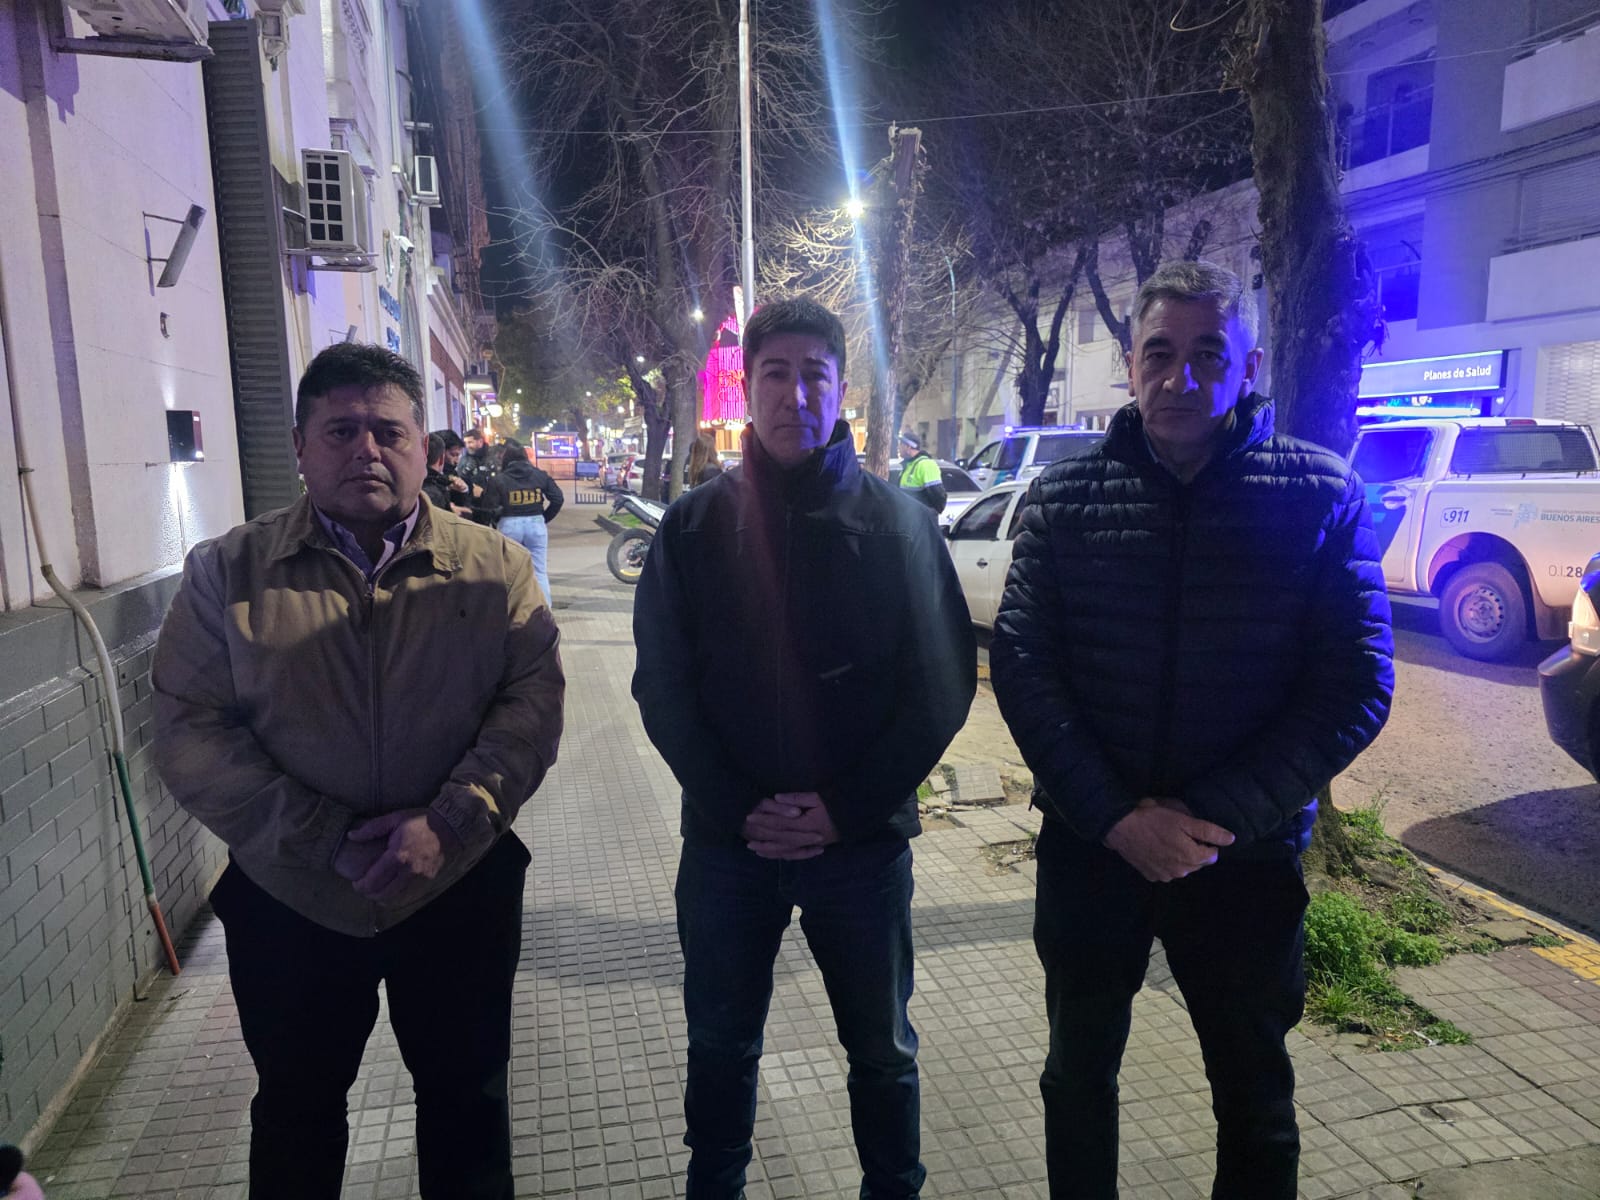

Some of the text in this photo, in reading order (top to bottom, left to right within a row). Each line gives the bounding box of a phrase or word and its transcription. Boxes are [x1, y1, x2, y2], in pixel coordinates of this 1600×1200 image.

[1423, 364, 1492, 381] Planes de Salud
[1449, 510, 1470, 523] 911
[1541, 513, 1600, 524] BUENOS AIRES
